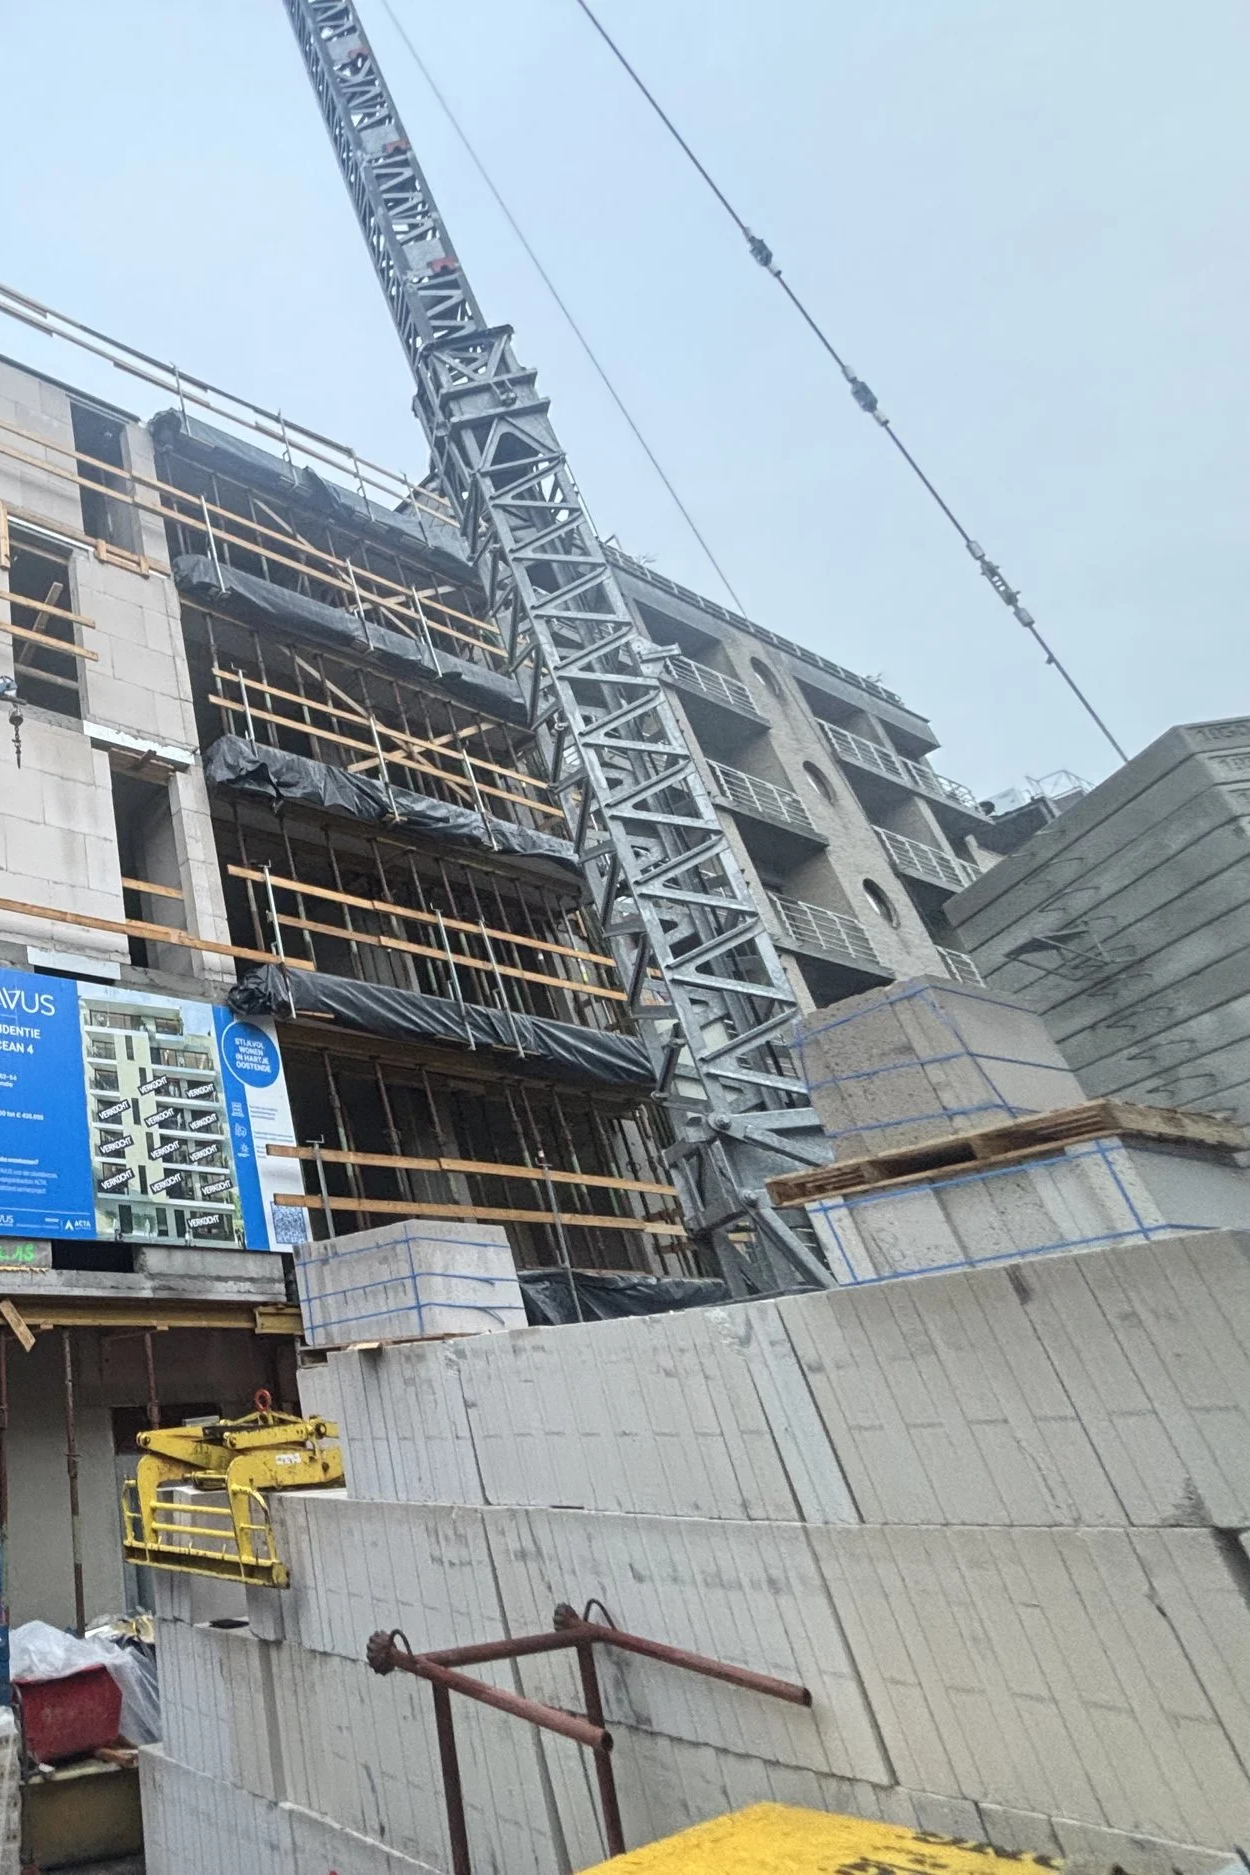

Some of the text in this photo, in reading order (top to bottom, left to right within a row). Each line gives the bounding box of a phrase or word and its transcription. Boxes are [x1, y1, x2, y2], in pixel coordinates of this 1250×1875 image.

[26, 1044, 34, 1055] 4
[238, 1046, 264, 1056] WONEN
[236, 1061, 272, 1073] OOSTENDE
[139, 1076, 168, 1095] VERKOCHT
[186, 1083, 215, 1098] VERKOCHT
[98, 1100, 129, 1120] VERKOCHT
[145, 1108, 175, 1127] VERKOCHT
[189, 1113, 218, 1130] VERKOCHT
[99, 1137, 132, 1154] VERKOCHT
[150, 1140, 180, 1159] VERKOCHT
[189, 1144, 218, 1161] VERKOCHT
[101, 1169, 133, 1190] VERKOCHT
[151, 1173, 182, 1193] VERKOCHT
[201, 1180, 232, 1195] VERKOCHT
[187, 1214, 220, 1228] VERKOCHT
